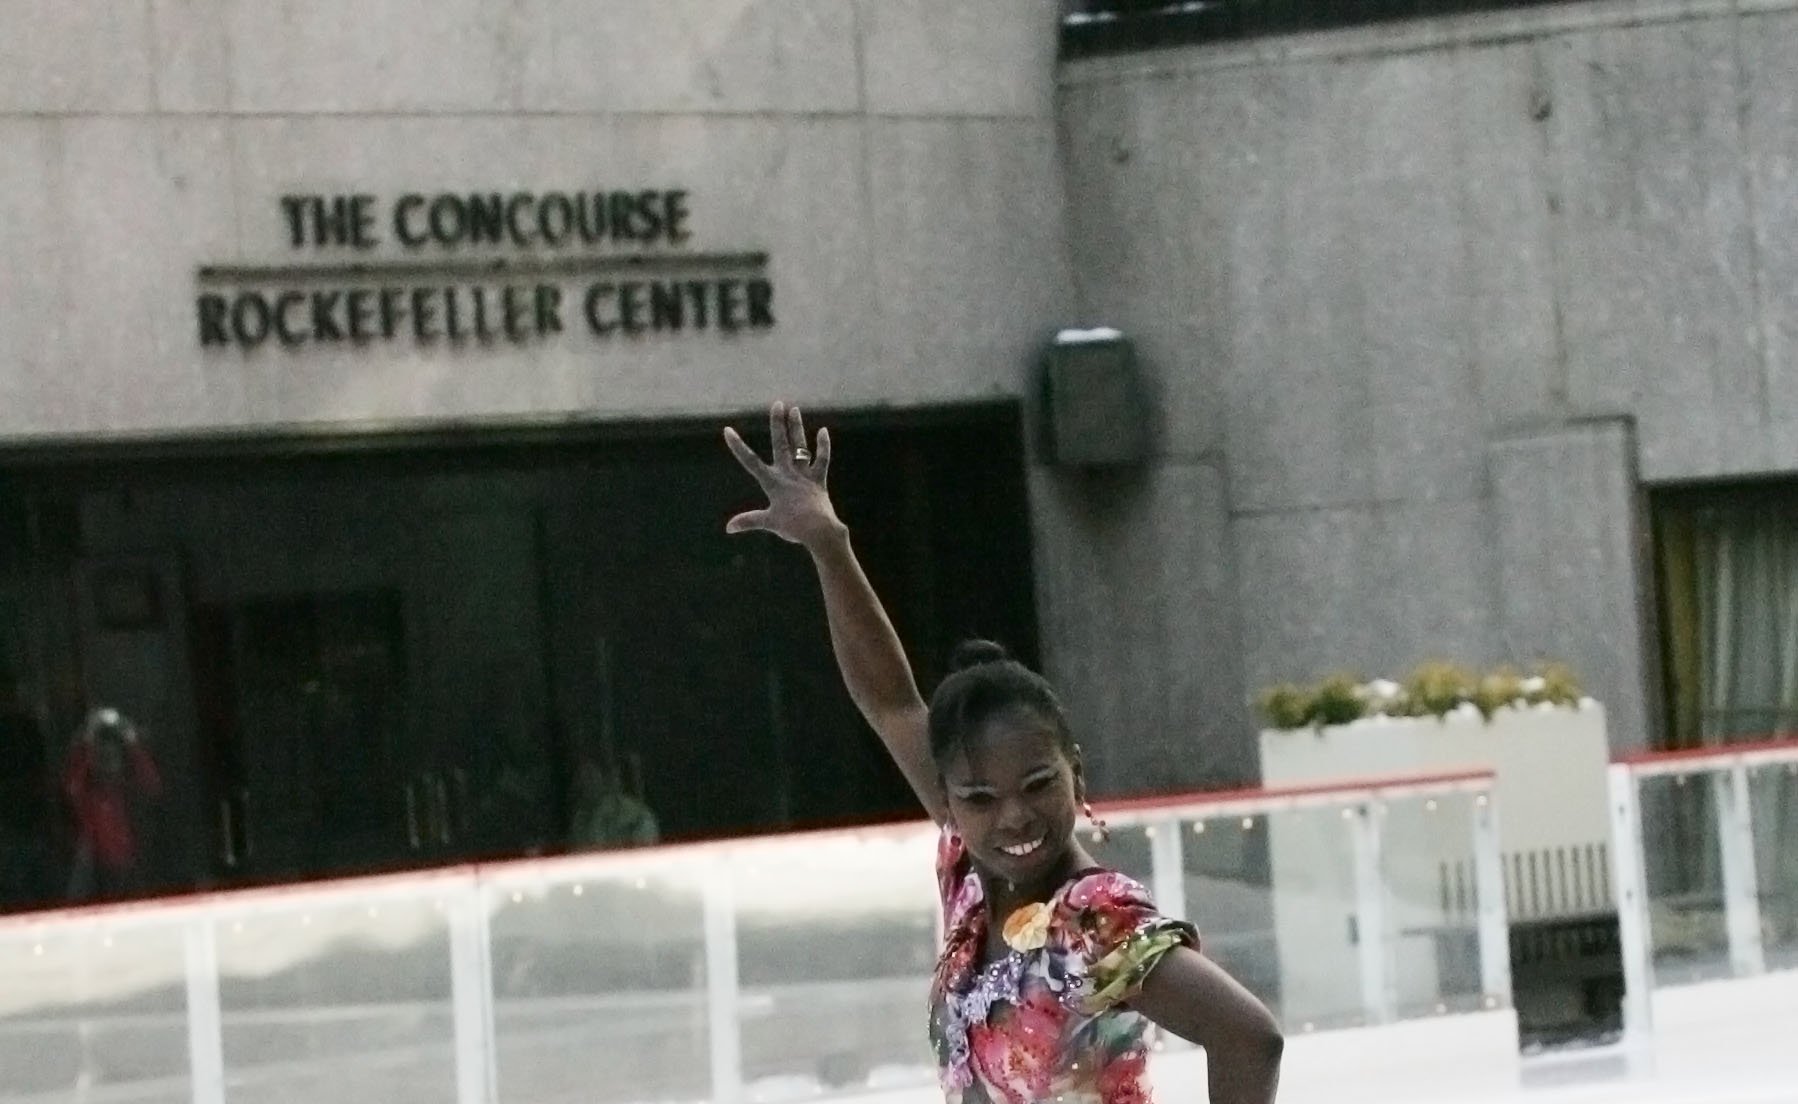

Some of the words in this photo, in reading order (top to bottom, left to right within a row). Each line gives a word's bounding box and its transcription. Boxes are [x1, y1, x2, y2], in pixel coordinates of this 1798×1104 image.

[281, 194, 379, 249] THE
[394, 189, 692, 248] CONCOURSE
[198, 284, 563, 348] ROCKEFELLER
[584, 278, 776, 336] CENTER
